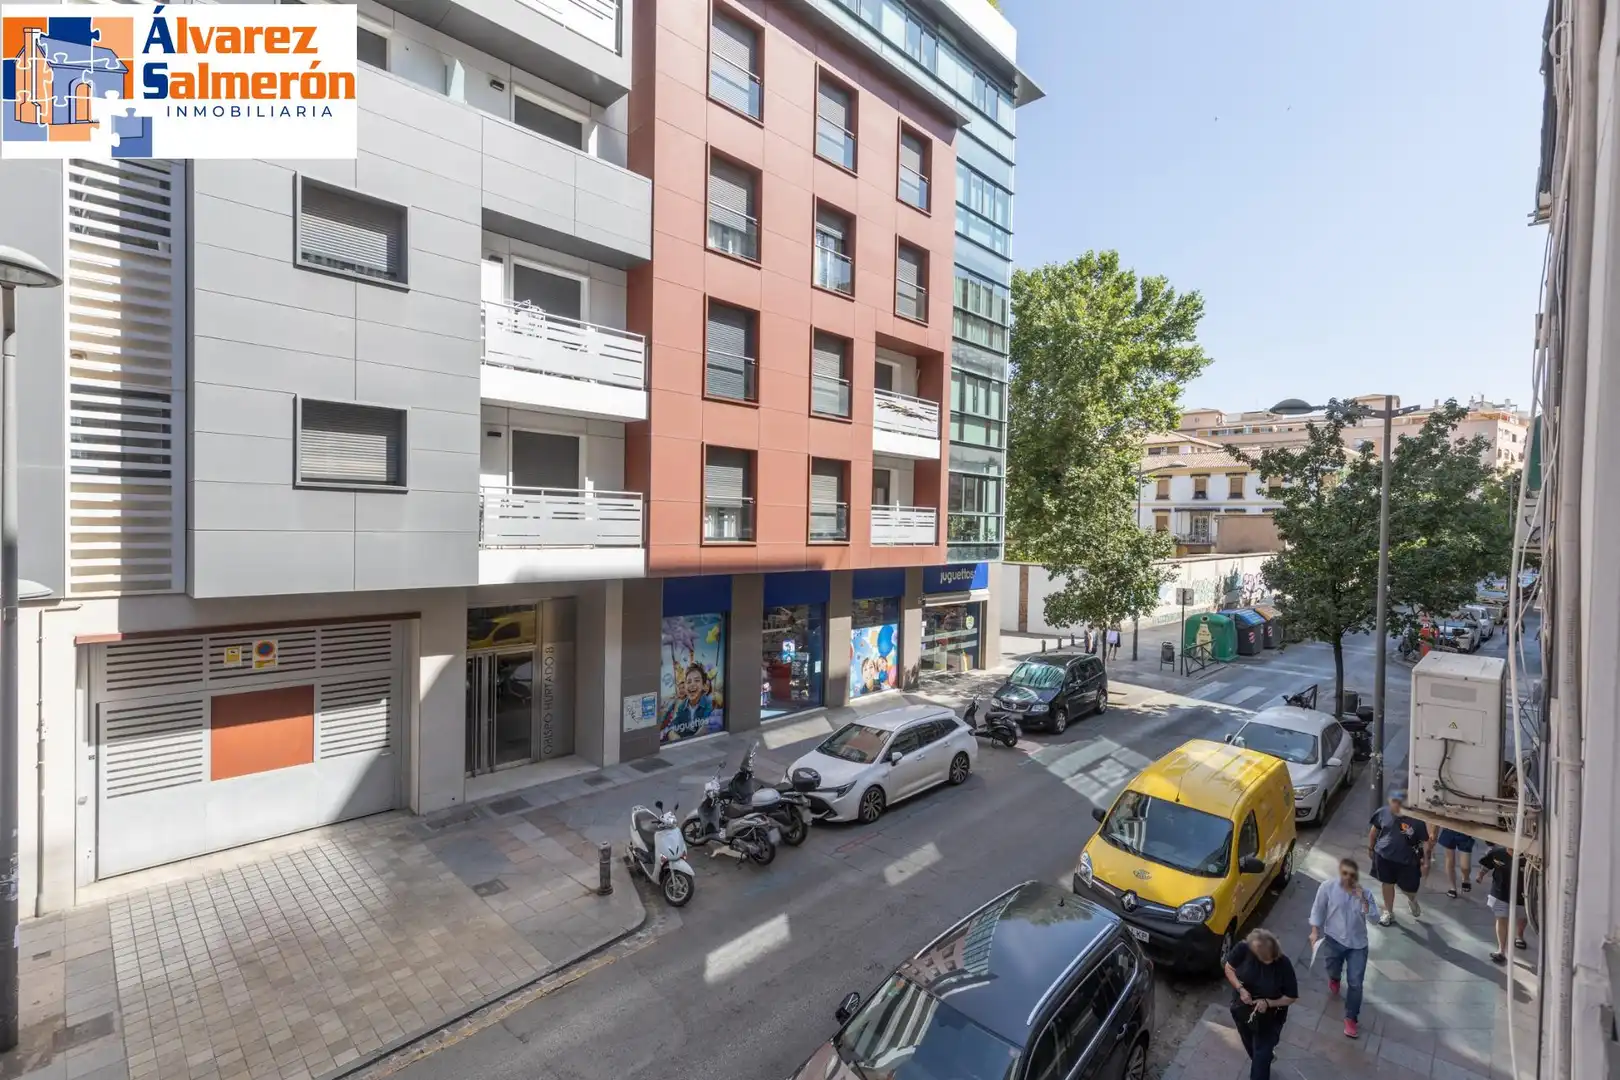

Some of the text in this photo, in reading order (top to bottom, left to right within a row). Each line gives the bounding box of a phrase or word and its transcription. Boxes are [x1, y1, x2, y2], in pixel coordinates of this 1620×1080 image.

[940, 568, 975, 584] juguettos
[544, 656, 555, 711] HURTADO
[543, 712, 553, 755] OBISPO
